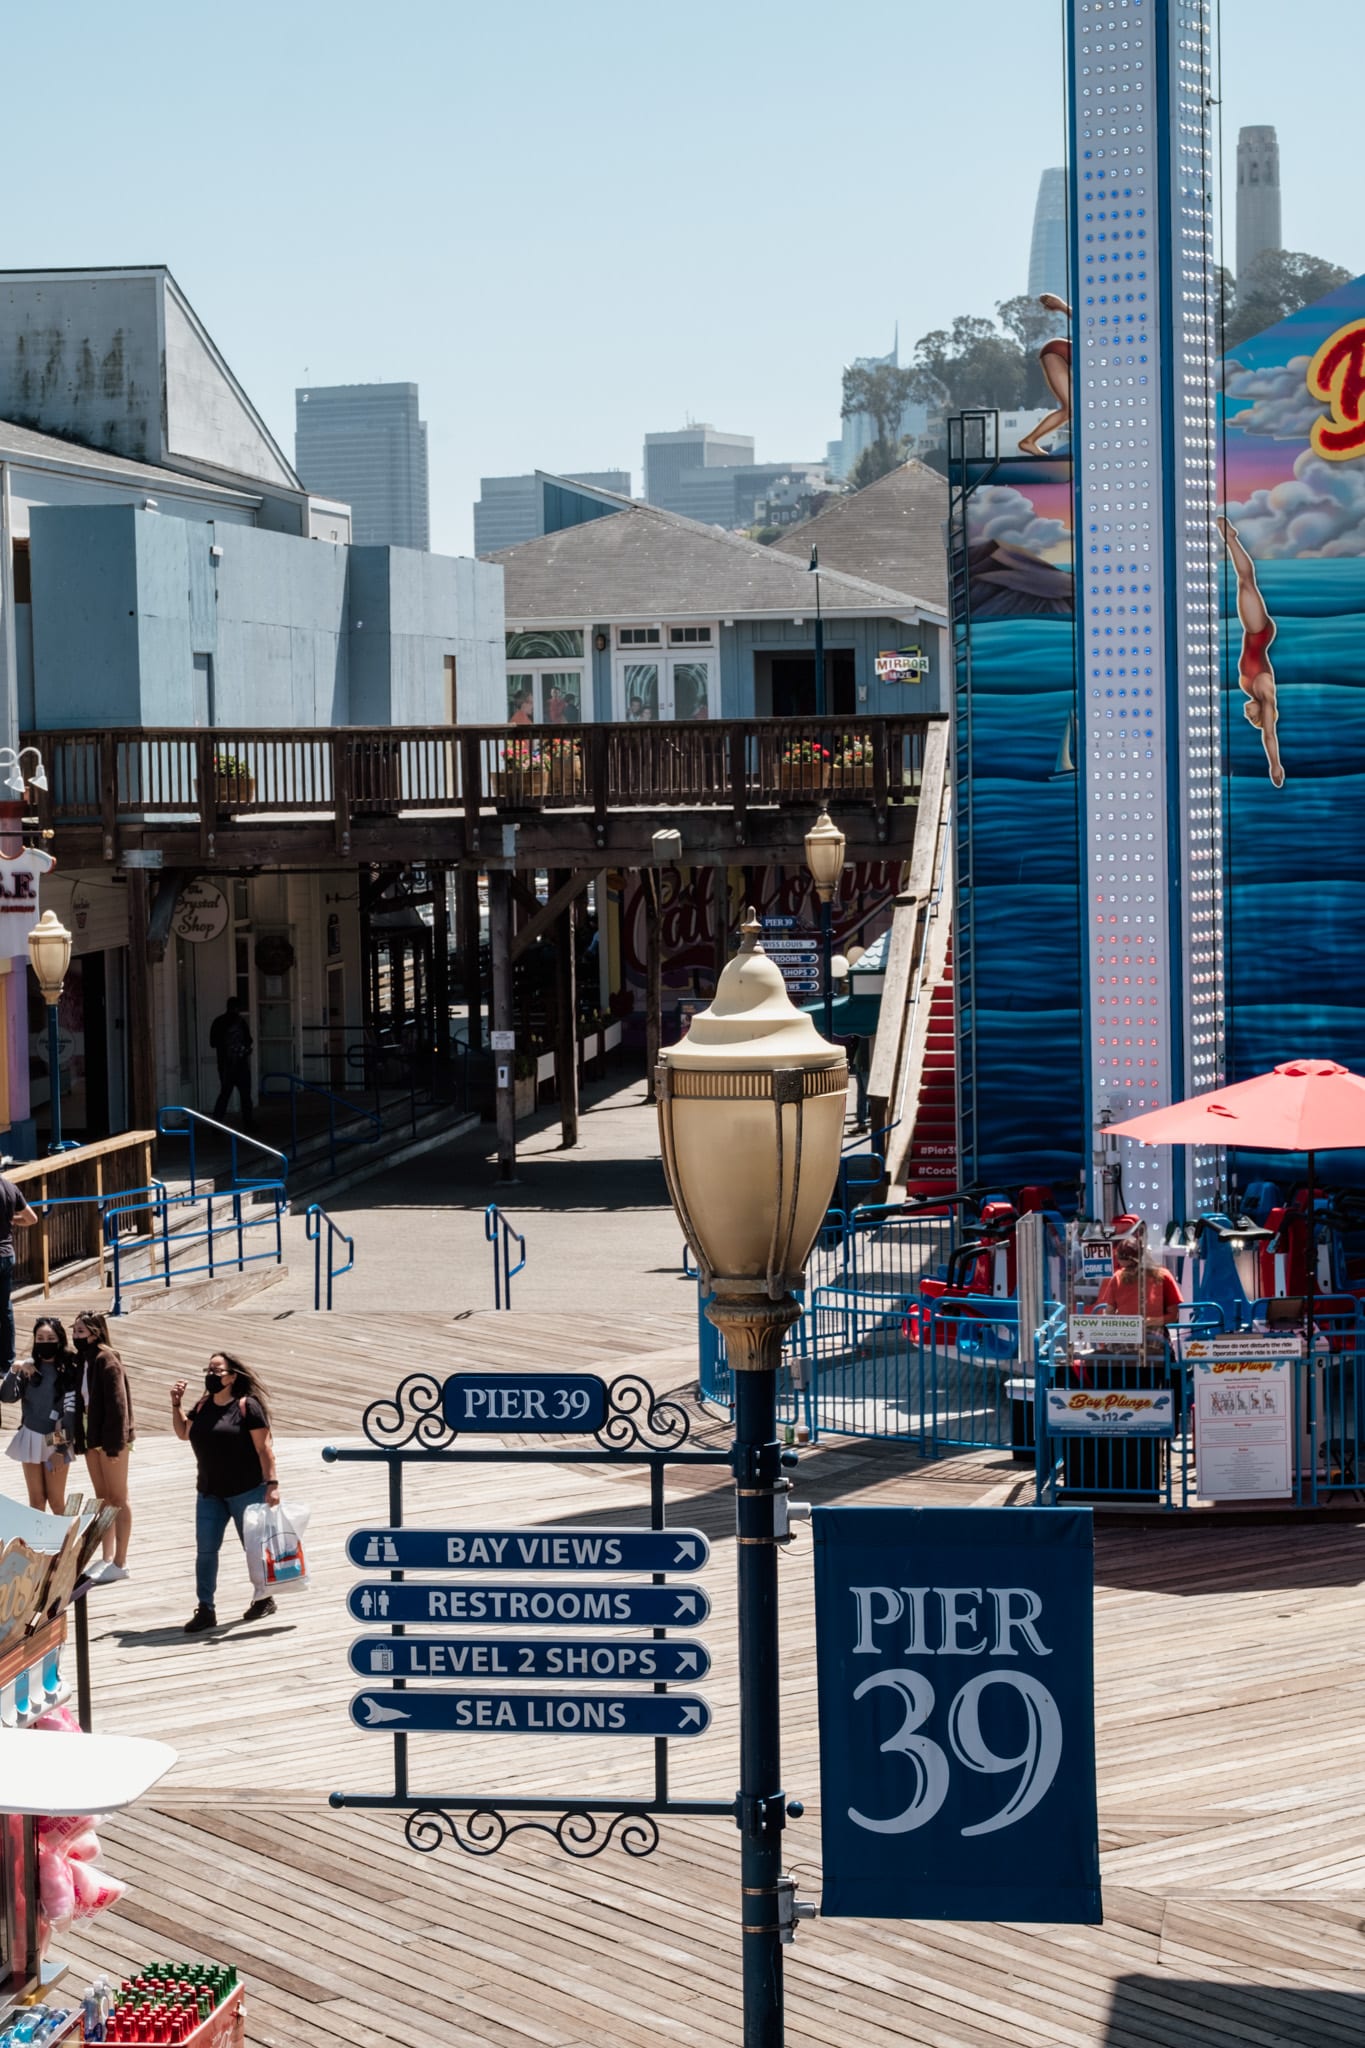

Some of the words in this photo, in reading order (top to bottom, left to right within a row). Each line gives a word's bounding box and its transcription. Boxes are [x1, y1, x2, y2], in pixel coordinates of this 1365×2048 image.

[877, 659, 927, 670] MIRROR
[174, 894, 221, 915] Crystal
[178, 915, 215, 938] Shop
[921, 1146, 957, 1154] #Pier3
[919, 1167, 957, 1175] #CocaC
[1084, 1245, 1111, 1258] OPEN
[1084, 1264, 1103, 1273] COME
[1104, 1264, 1112, 1272] IN
[1073, 1320, 1098, 1328] NOW
[1101, 1320, 1140, 1328] HIRING!
[1213, 1361, 1237, 1374] Bay
[1239, 1361, 1273, 1374] Plunge
[463, 1388, 550, 1419] PIER
[552, 1389, 591, 1420] 39
[1068, 1393, 1101, 1410] Bay
[1101, 1393, 1153, 1412] Plunge
[1101, 1412, 1119, 1422] $12
[446, 1537, 509, 1563] BAY
[517, 1538, 623, 1565] VIEWS
[428, 1590, 632, 1620] RESTROOMS
[849, 1586, 1053, 1655] PIER
[410, 1646, 508, 1673] LEVEL
[518, 1648, 537, 1673] 2
[546, 1648, 657, 1674] SHOPS
[455, 1700, 518, 1727] SEA
[527, 1702, 626, 1728] LIONS
[848, 1668, 1063, 1836] 39
